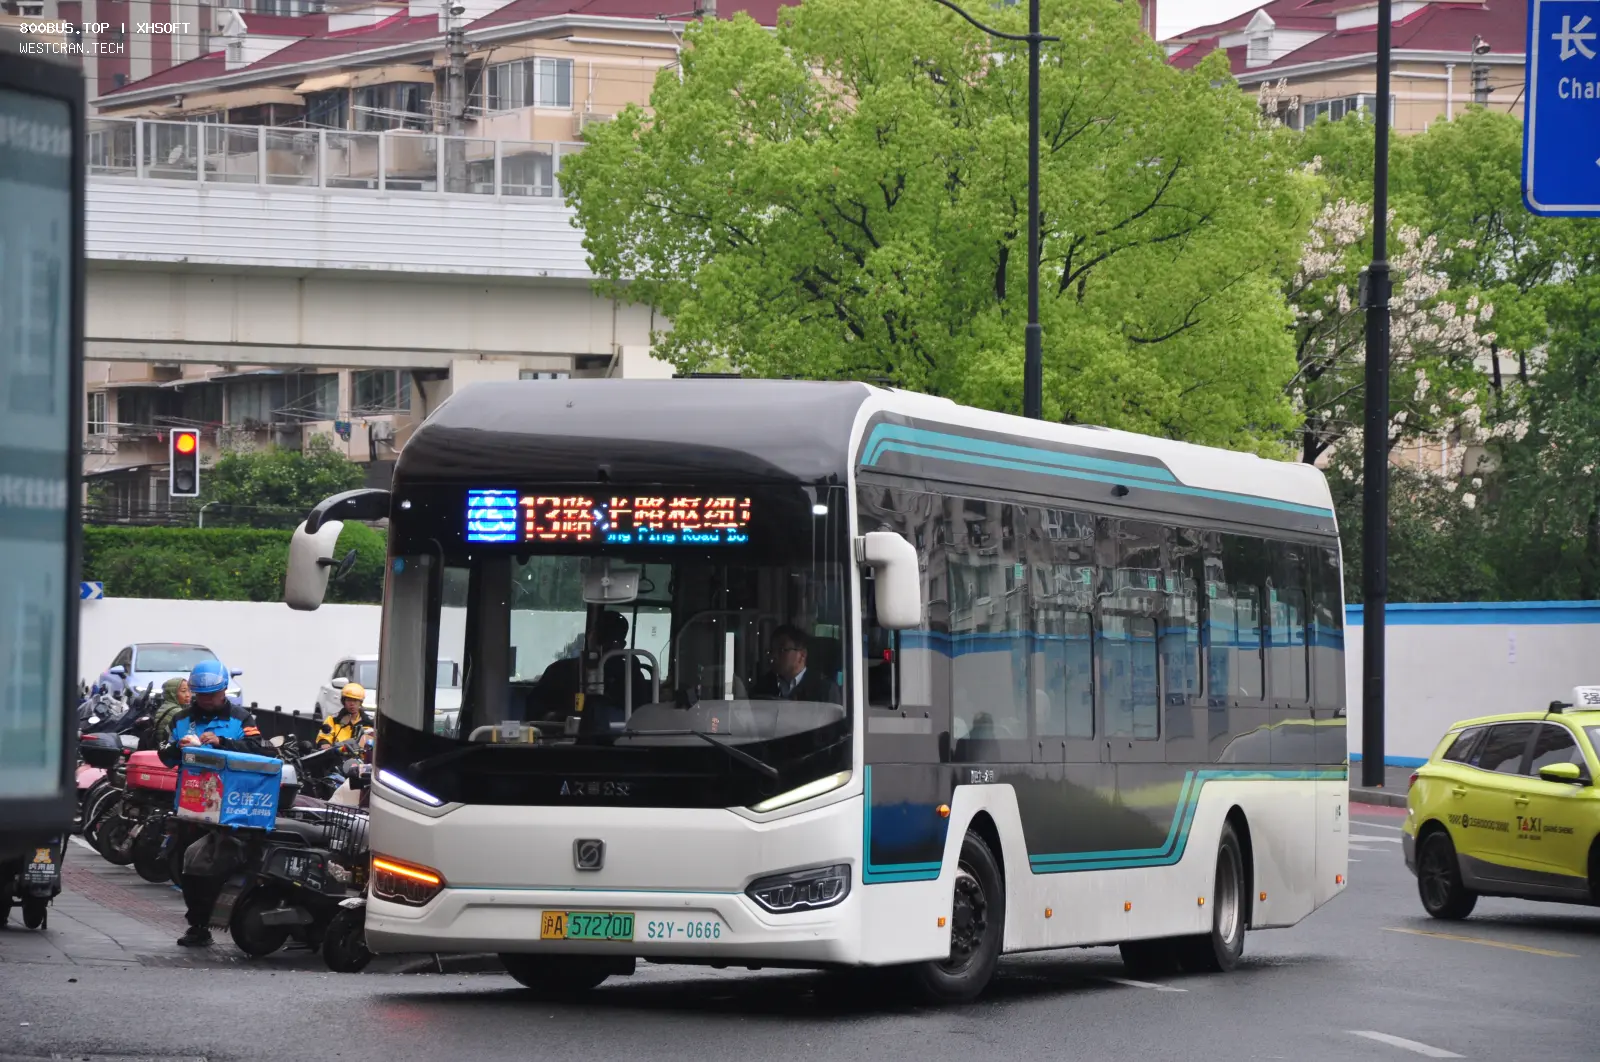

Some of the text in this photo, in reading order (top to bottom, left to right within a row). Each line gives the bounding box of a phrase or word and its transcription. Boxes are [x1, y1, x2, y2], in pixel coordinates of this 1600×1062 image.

[1551, 15, 1597, 62] 长
[1516, 815, 1542, 832] TAXI
[648, 921, 721, 939] S2Y-0666
